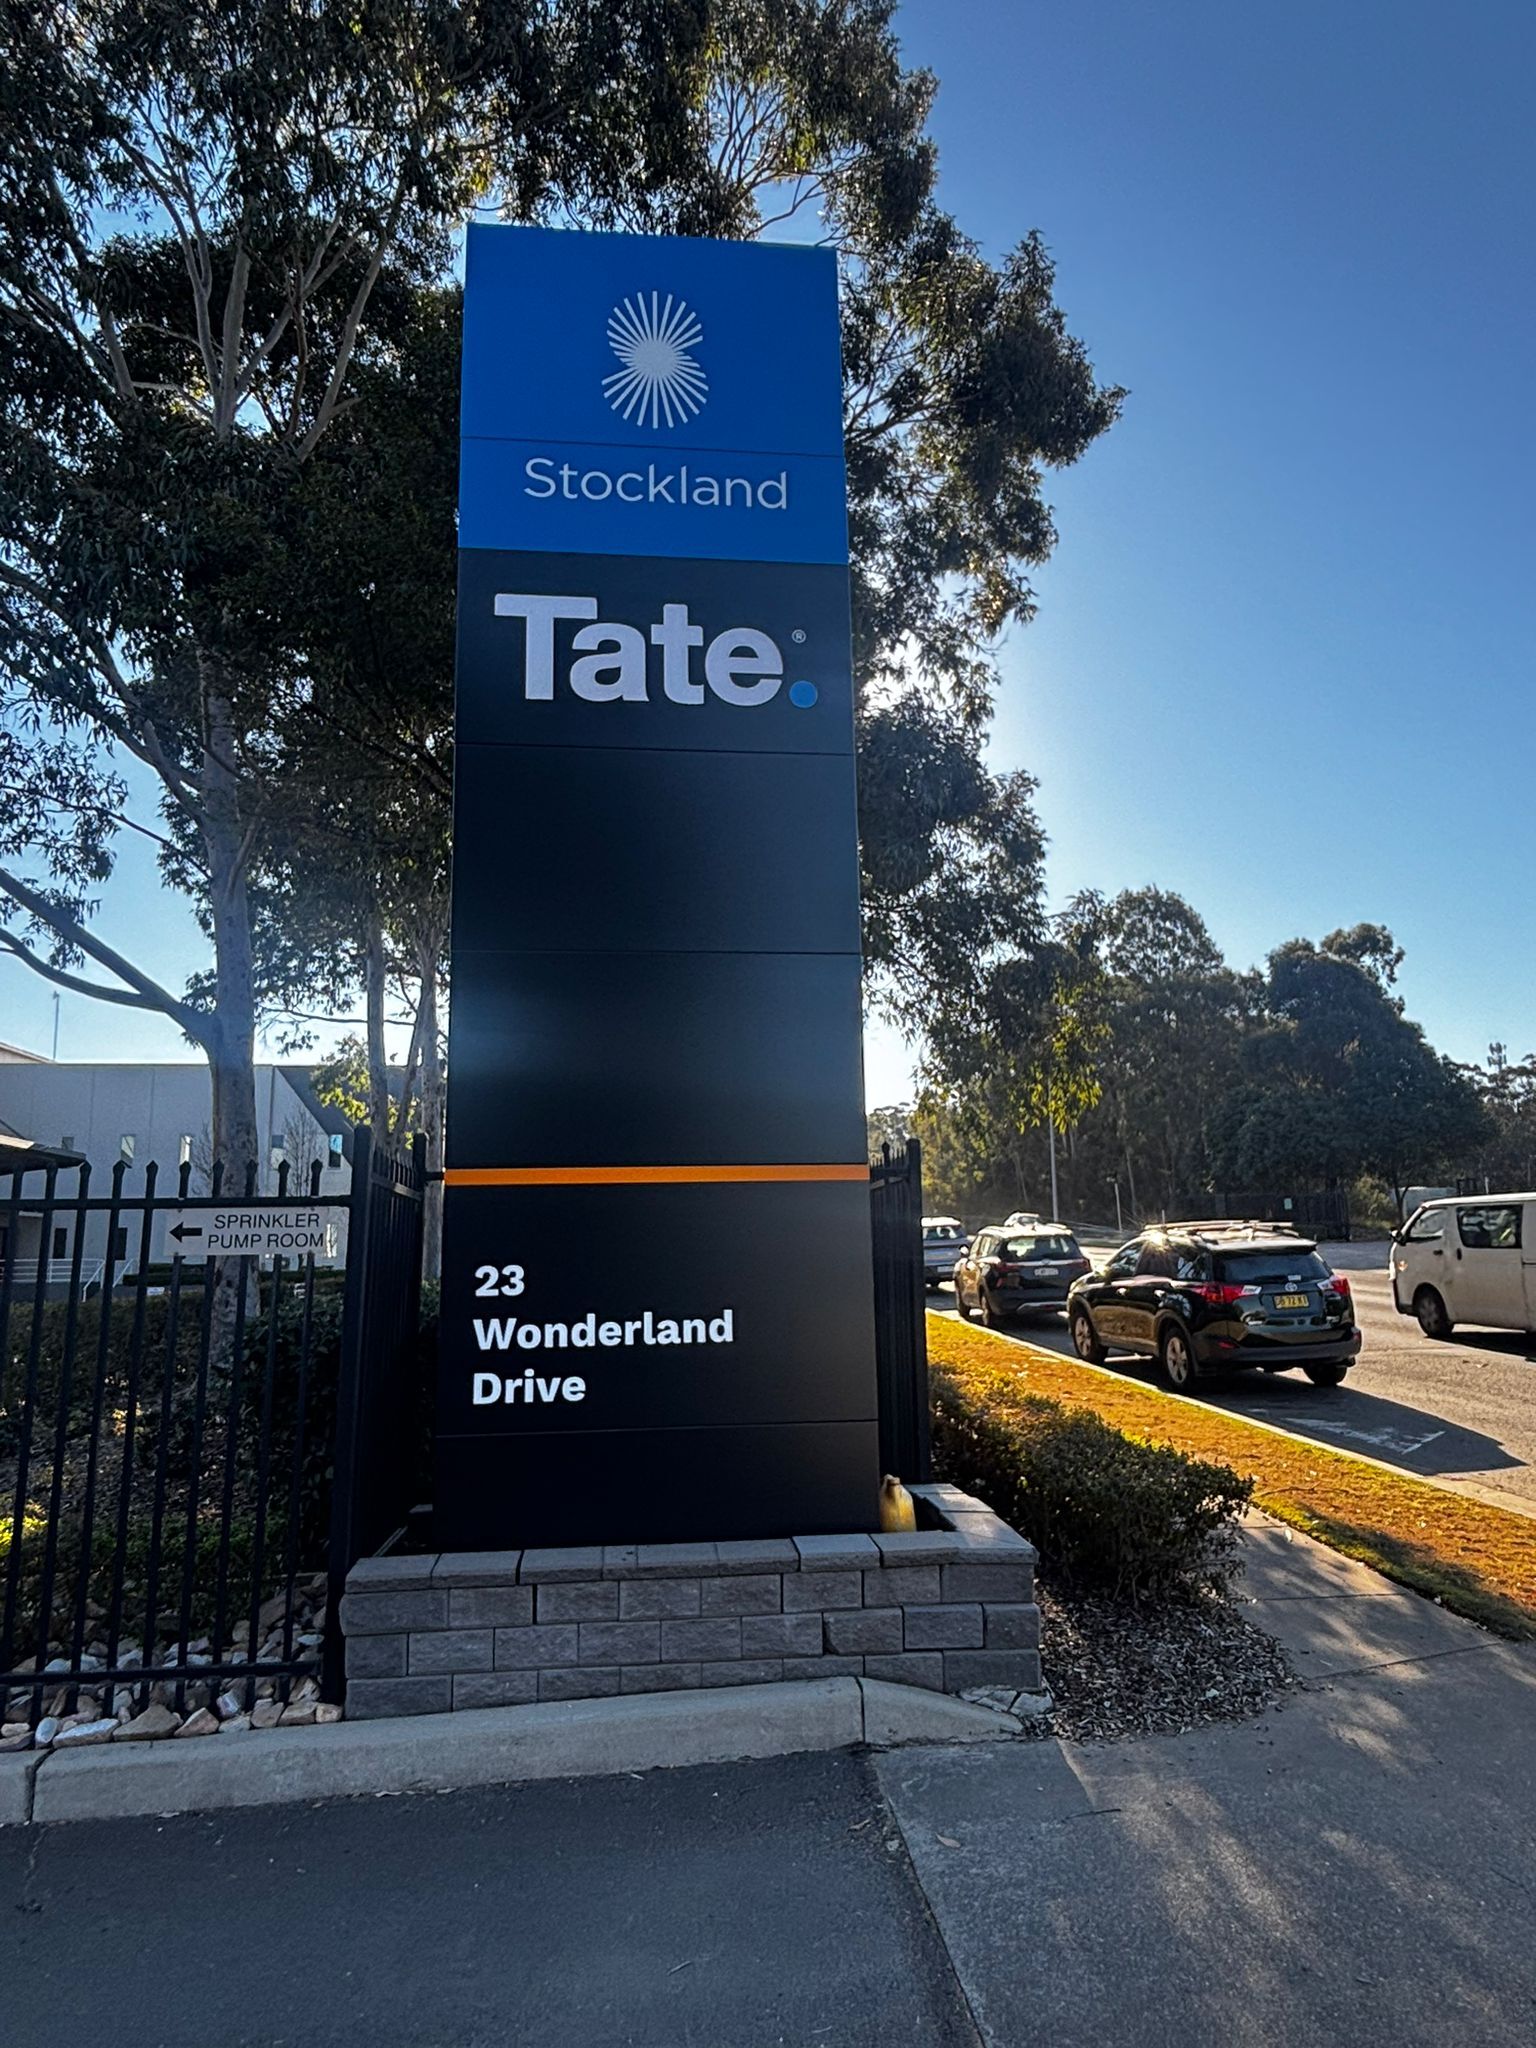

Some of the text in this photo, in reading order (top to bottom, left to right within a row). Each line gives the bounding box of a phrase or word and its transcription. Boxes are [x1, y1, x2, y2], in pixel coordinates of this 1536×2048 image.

[524, 457, 787, 509] Stockland
[214, 1213, 320, 1229] SPRINKLER
[208, 1233, 324, 1248] PUMP ROOM
[475, 1265, 525, 1297] 23
[473, 1309, 734, 1350] Wonderland
[472, 1369, 586, 1405] Drive
